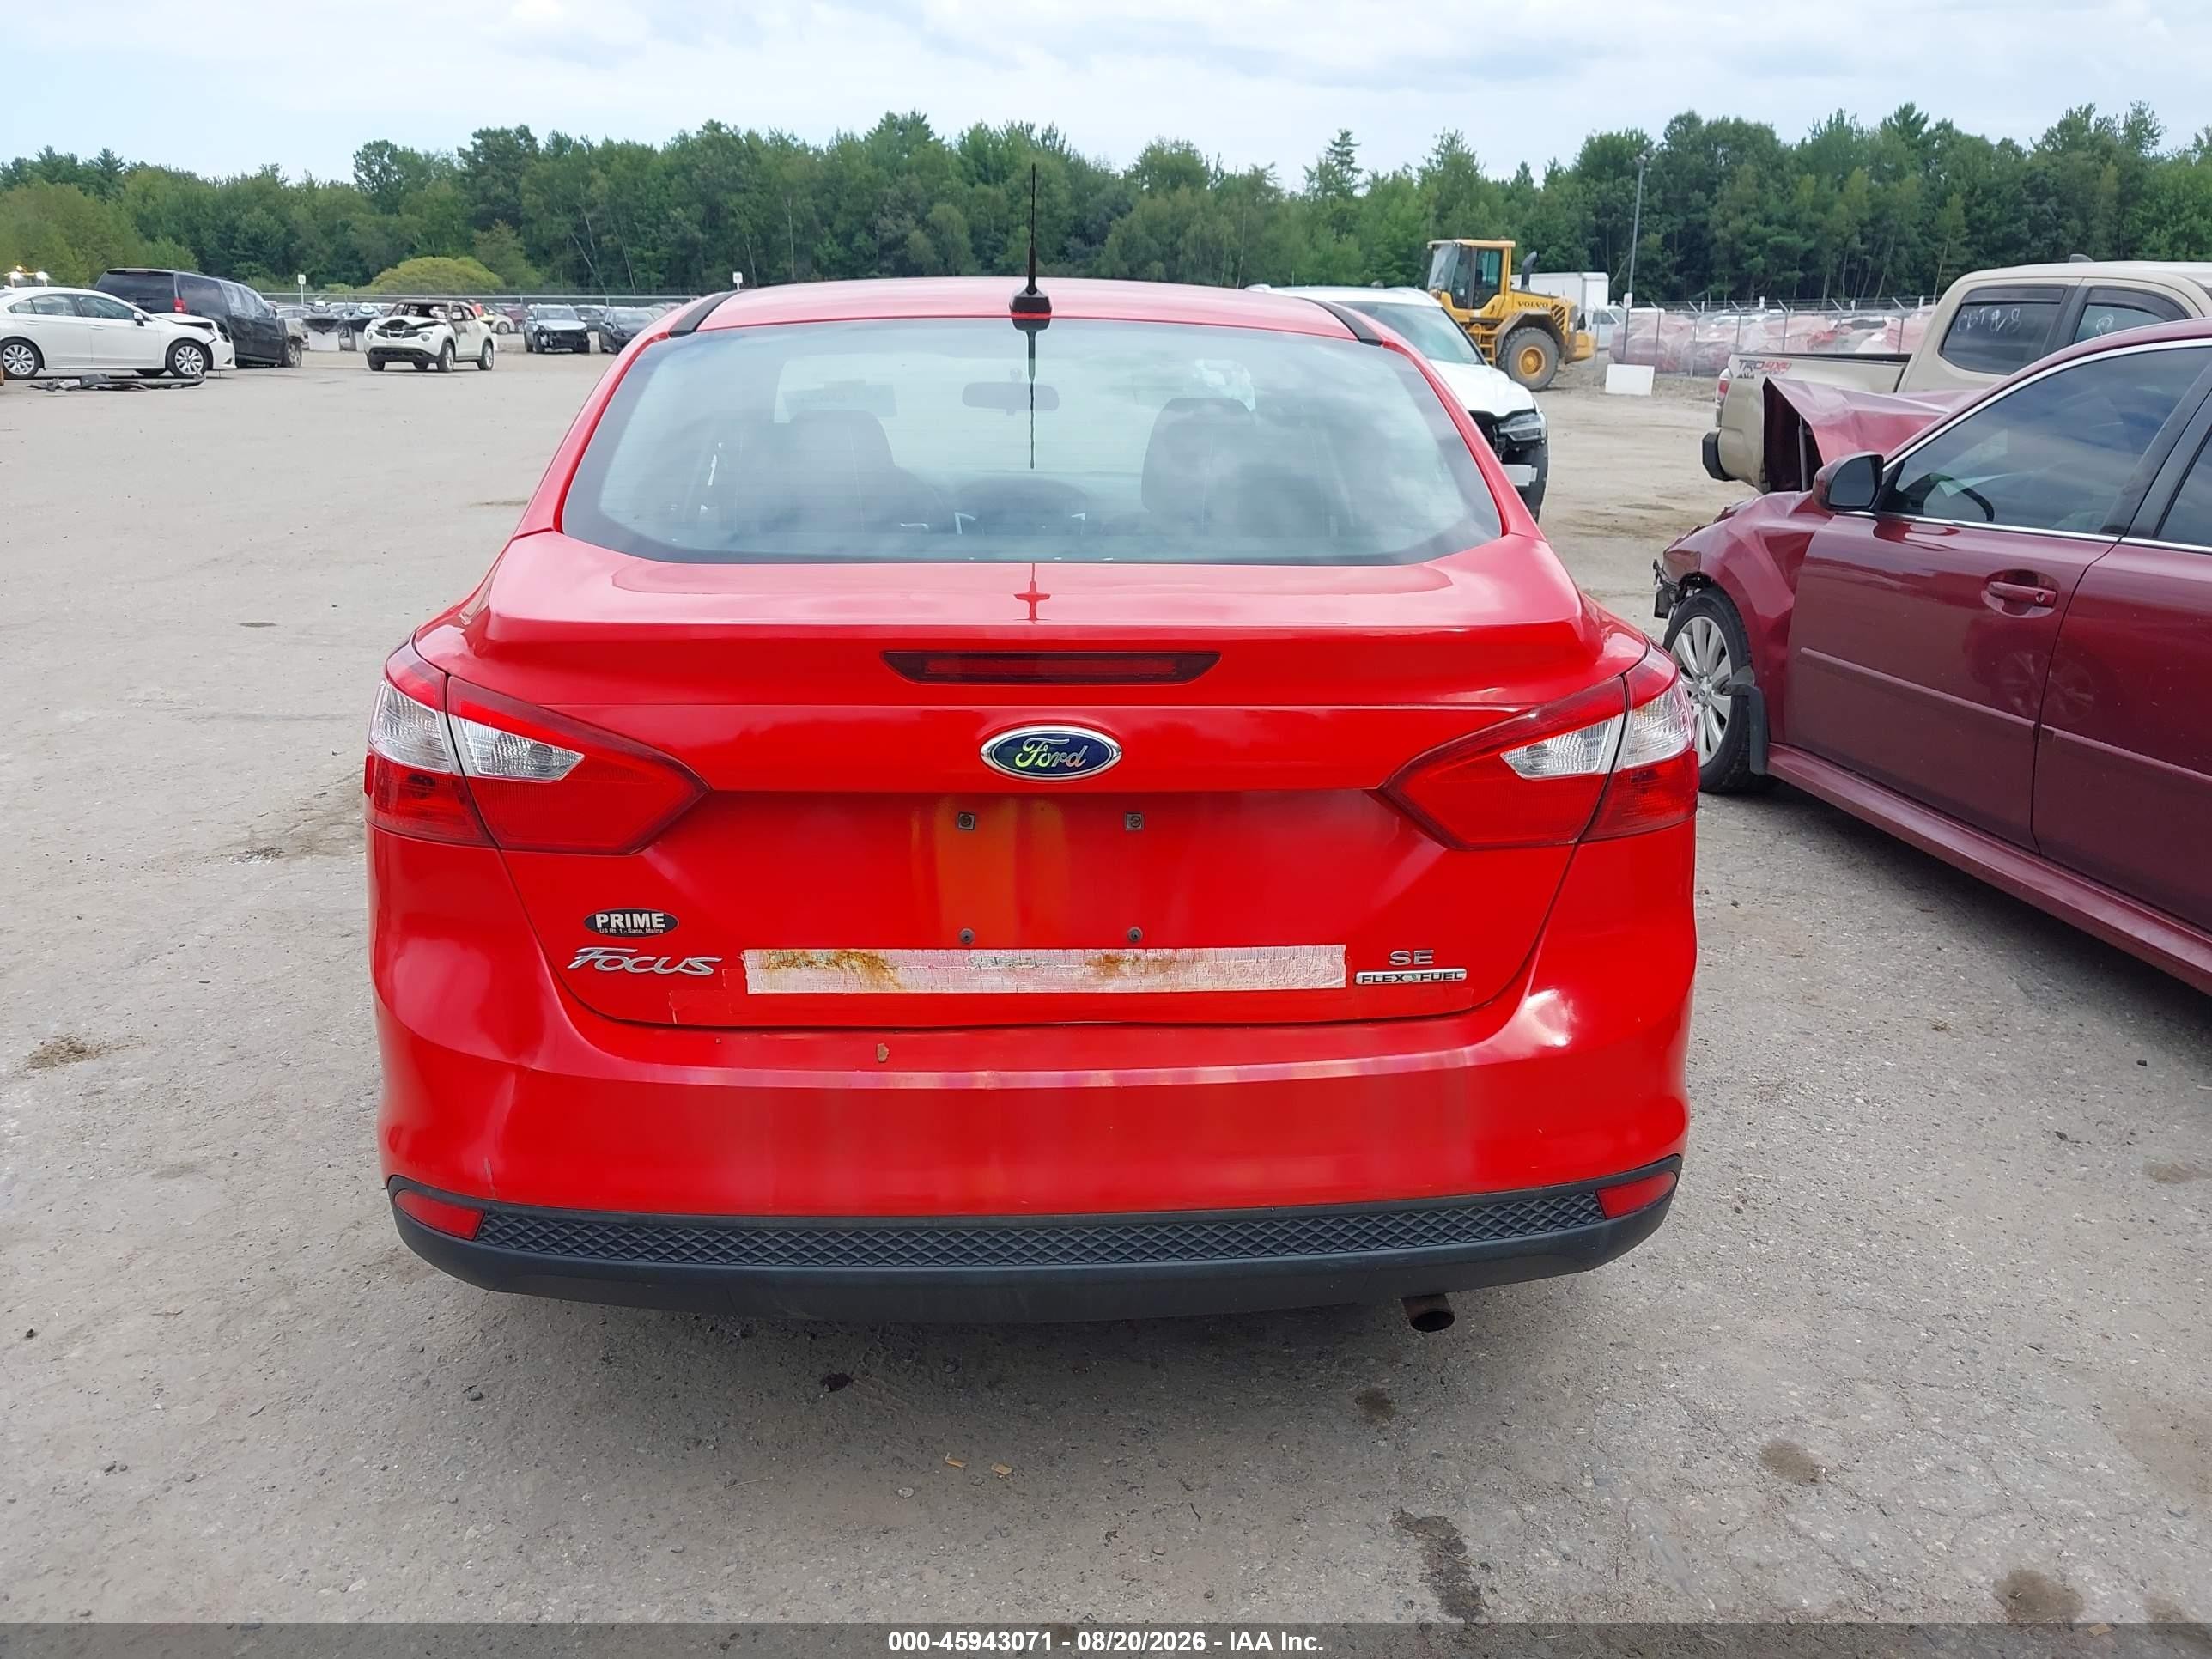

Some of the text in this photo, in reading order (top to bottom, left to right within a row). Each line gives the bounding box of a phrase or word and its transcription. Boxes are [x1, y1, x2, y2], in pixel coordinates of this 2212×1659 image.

[1014, 737, 1089, 769] Ford
[595, 913, 665, 929] PRIME
[1389, 949, 1435, 966] SE
[1361, 971, 1463, 984] FLEX FUEL
